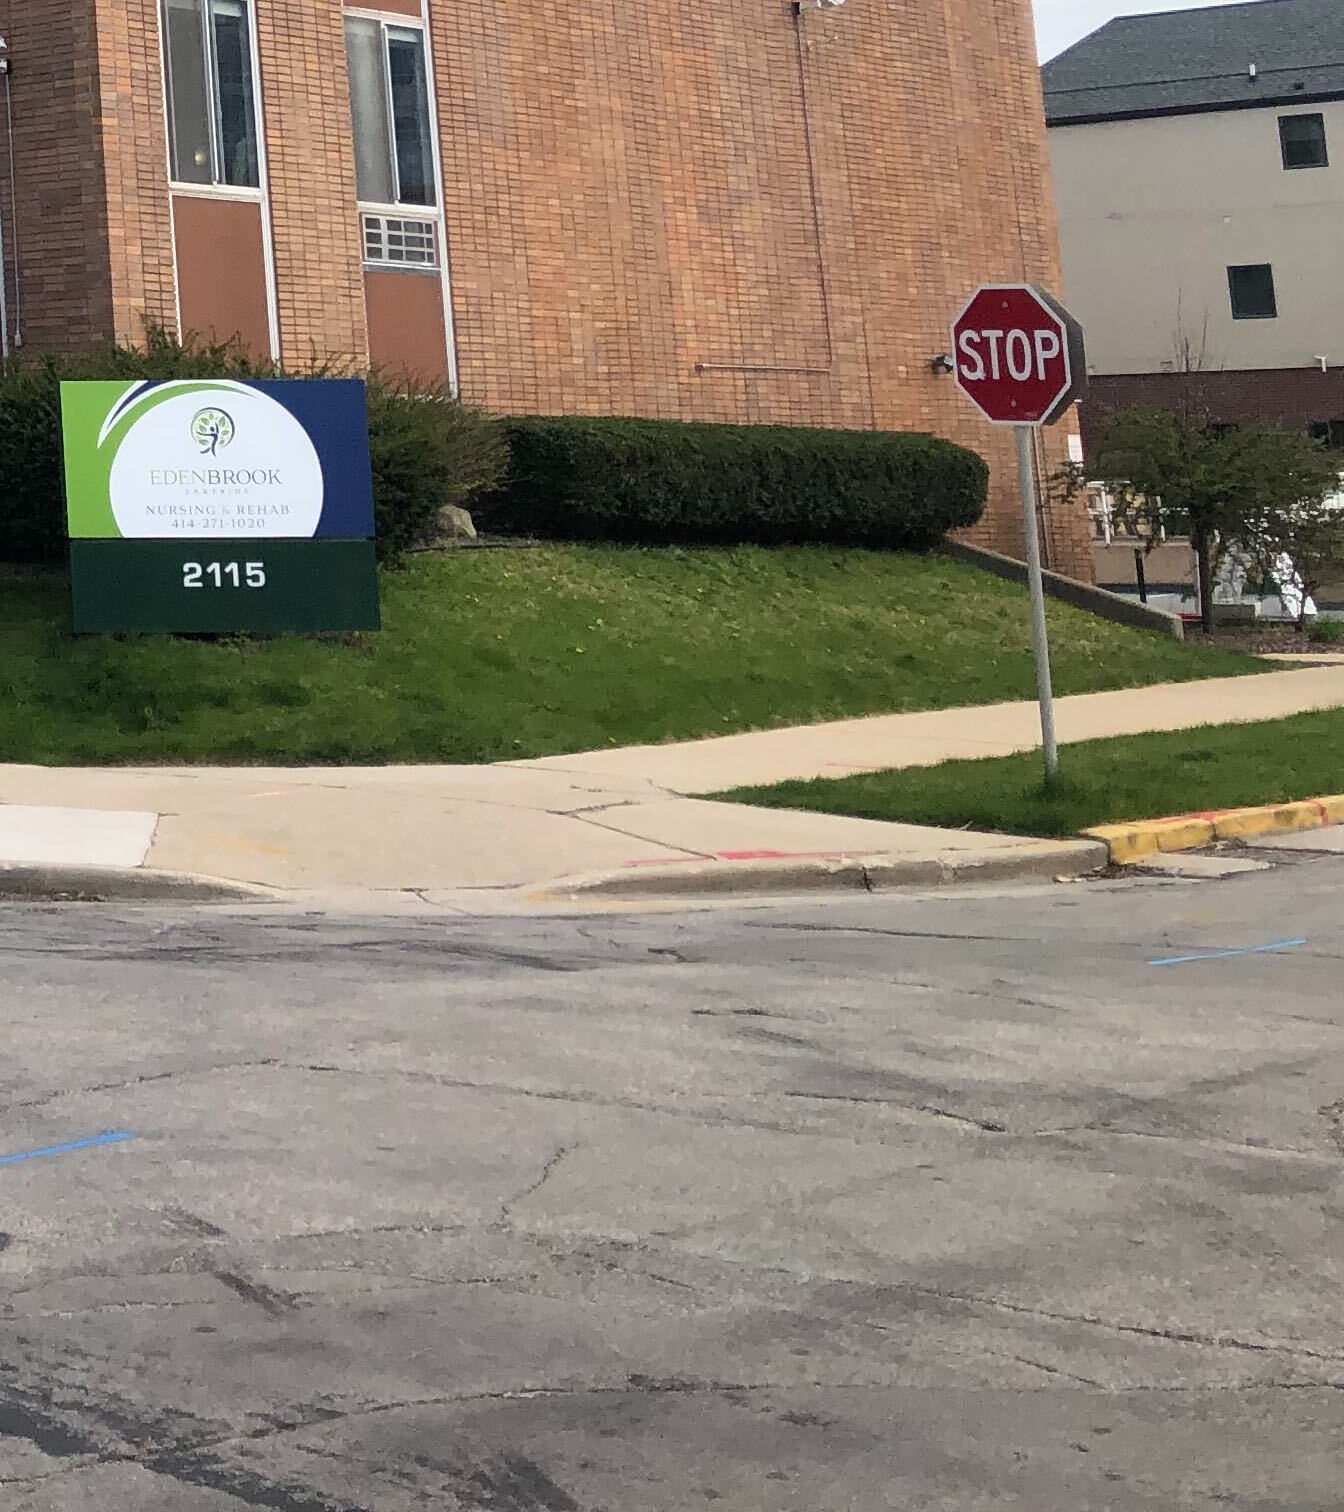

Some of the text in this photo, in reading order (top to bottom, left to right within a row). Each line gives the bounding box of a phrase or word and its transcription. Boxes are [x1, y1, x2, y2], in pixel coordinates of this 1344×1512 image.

[959, 329, 1060, 381] STOP
[150, 469, 283, 485] EDENBROOK
[146, 504, 216, 515] NURSING
[237, 504, 290, 515] REHAB
[172, 518, 265, 529] 414-271-1020
[182, 562, 266, 588] 2115
